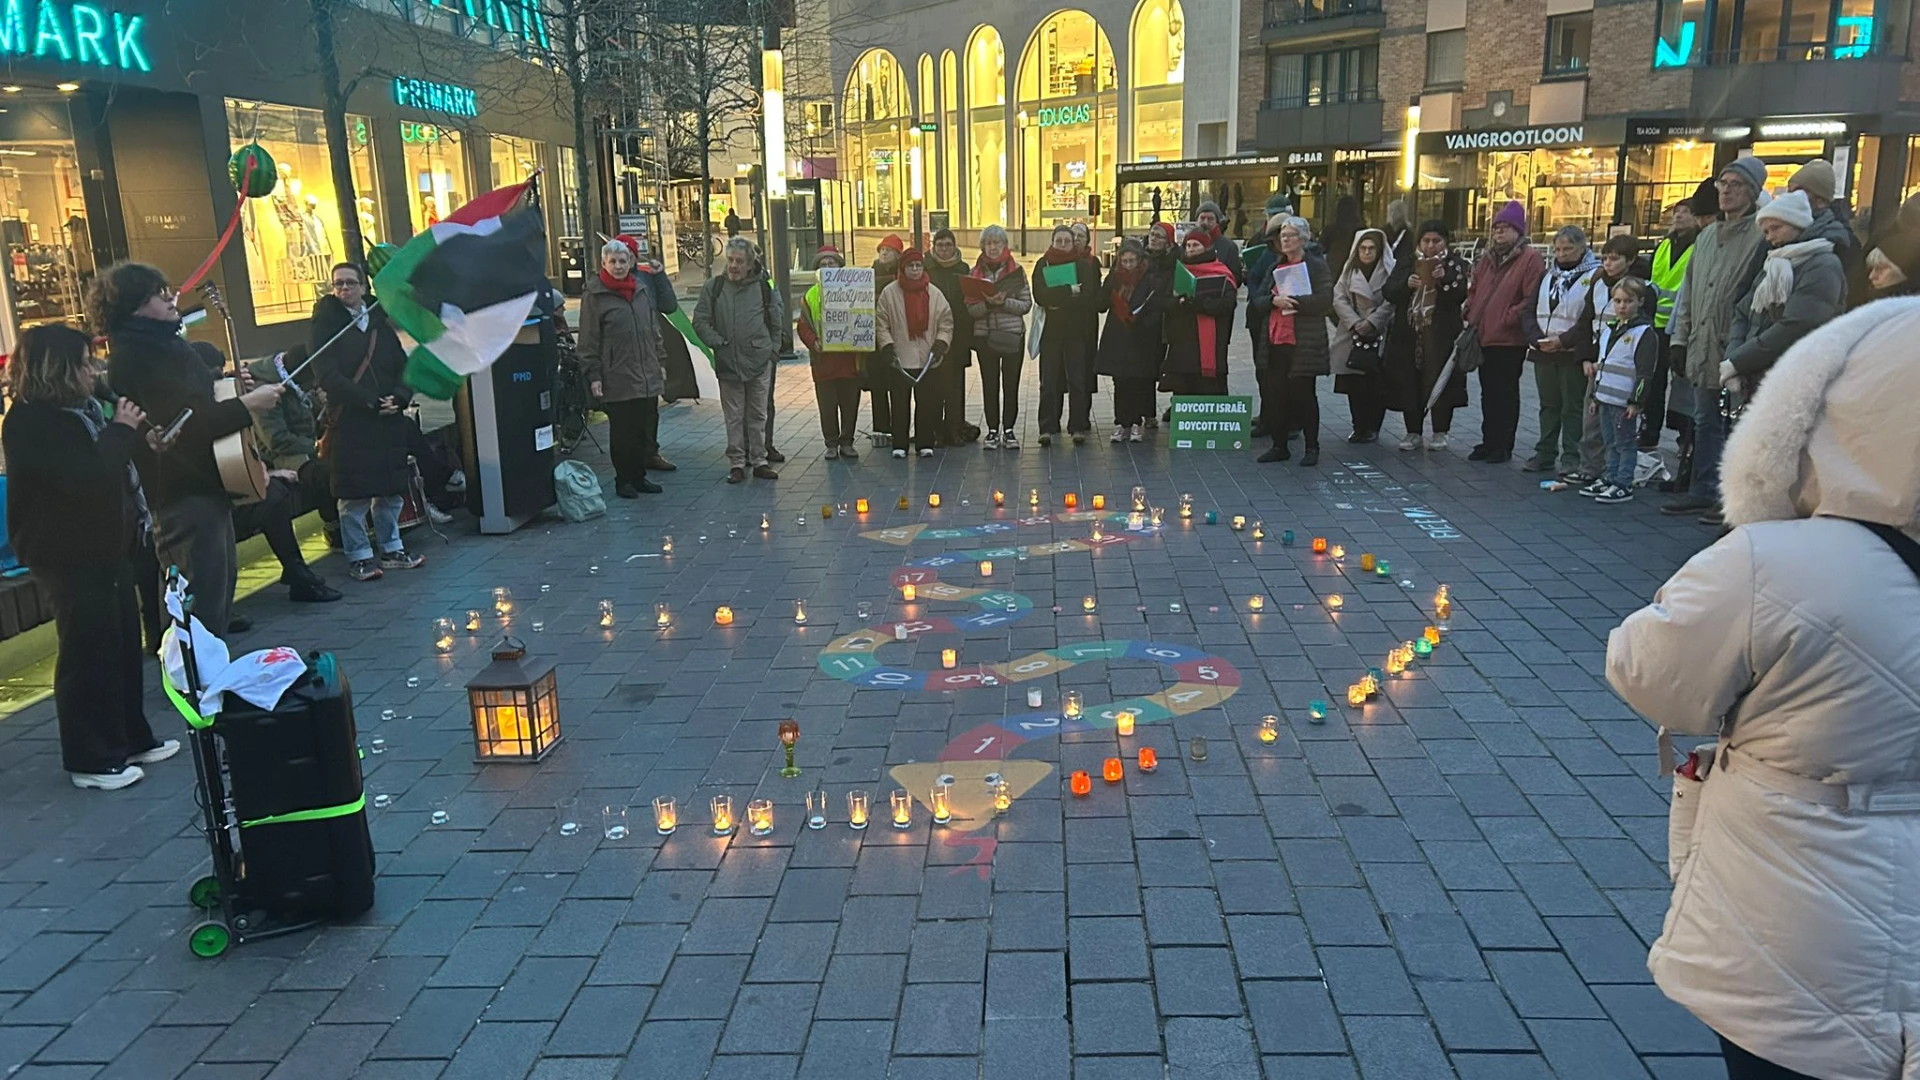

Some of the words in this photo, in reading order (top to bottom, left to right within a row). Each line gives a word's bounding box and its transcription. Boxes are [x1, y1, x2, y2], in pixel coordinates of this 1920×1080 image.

[395, 76, 478, 116] PRIMARK
[1038, 104, 1090, 127] DOUGLAS
[1445, 126, 1584, 149] VANGROOTLOON
[825, 271, 832, 283] 2
[1175, 402, 1215, 413] BOYCOTT
[1216, 401, 1247, 413] ISRAËL
[1178, 421, 1218, 431] BOYCOTT
[1219, 421, 1241, 431] TEVA
[980, 593, 1015, 605] 15
[968, 613, 1007, 626] 14
[841, 636, 875, 649] 12
[832, 656, 865, 671] 11
[1014, 660, 1050, 673] 8
[868, 672, 913, 685] 10
[1198, 664, 1220, 681] 5
[1167, 690, 1204, 703] 4
[1019, 718, 1060, 730] 2
[972, 736, 996, 754] 1
